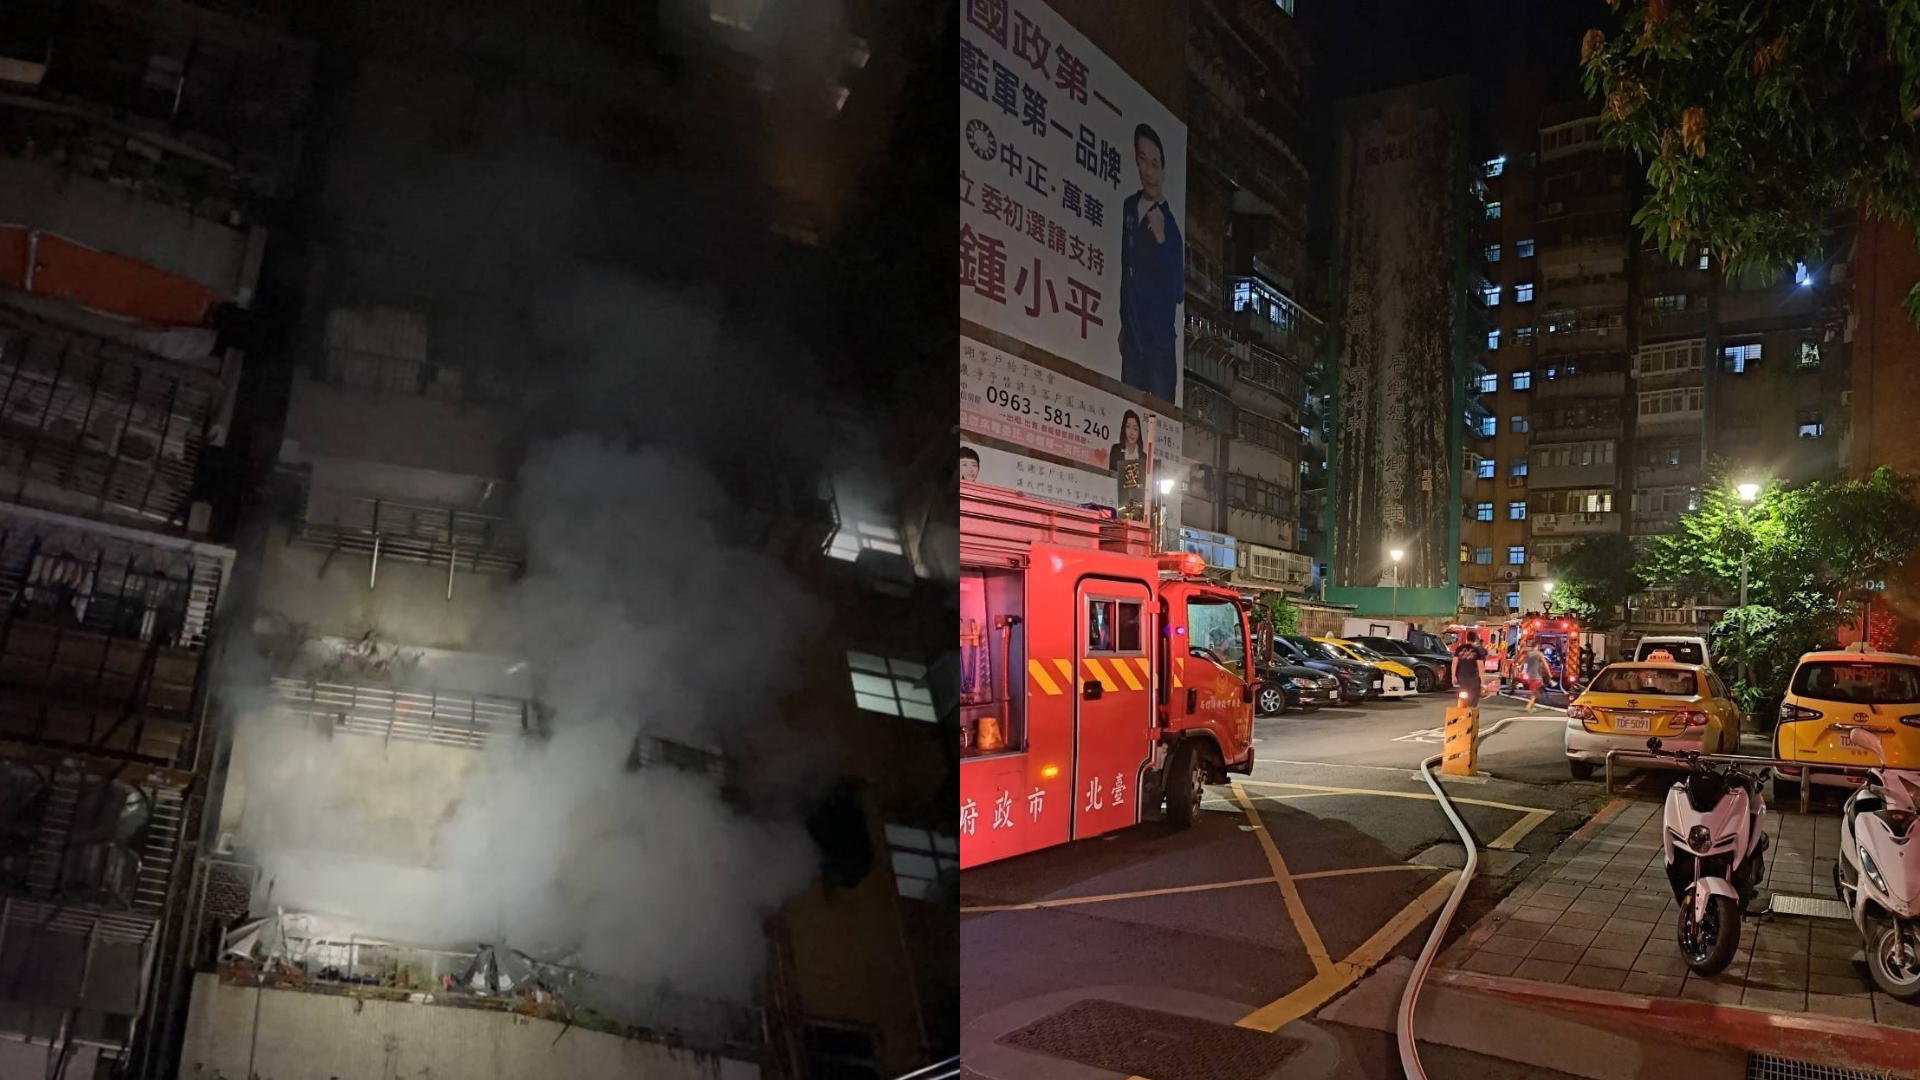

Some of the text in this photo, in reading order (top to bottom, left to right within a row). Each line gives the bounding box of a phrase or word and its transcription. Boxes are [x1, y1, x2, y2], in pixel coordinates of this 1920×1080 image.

[960, 37, 1122, 191] 藍軍第一品牌
[966, 0, 1123, 117] 國政第一
[960, 170, 1105, 276] 立委初選請支持
[960, 222, 1104, 340] 鍾小平
[986, 385, 1109, 440] 0963-581-240
[1616, 718, 1648, 730] TDF-5091
